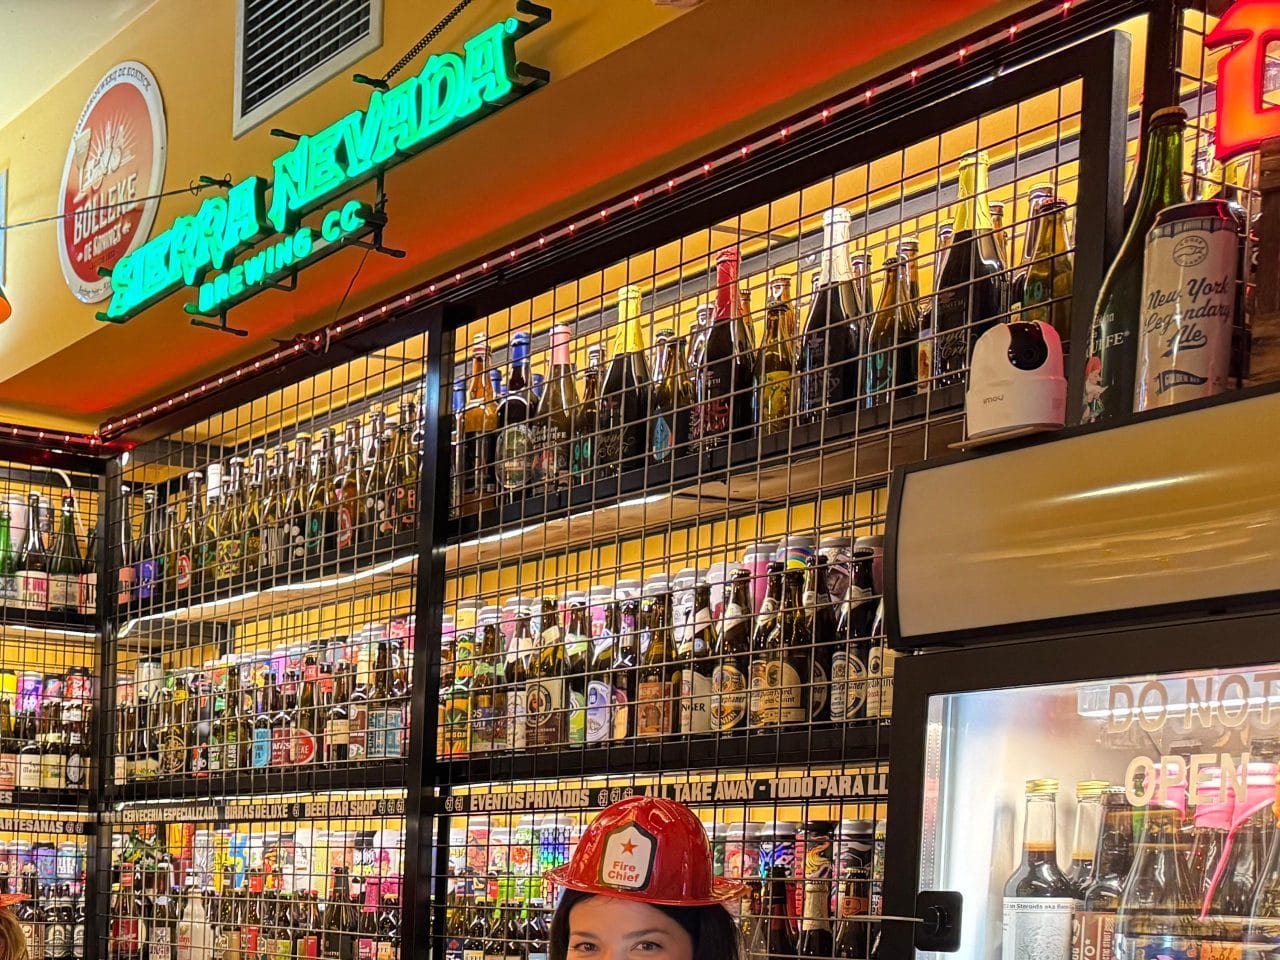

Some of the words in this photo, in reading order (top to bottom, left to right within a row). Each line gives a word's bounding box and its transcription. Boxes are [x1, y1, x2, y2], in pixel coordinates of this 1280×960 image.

[74, 174, 138, 244] BOLLEKE
[1147, 289, 1182, 311] New
[1187, 276, 1229, 298] York
[1144, 298, 1232, 336] Legendary
[1108, 680, 1170, 734] DO
[673, 781, 712, 803] TAKE
[714, 779, 756, 801] AWAY
[767, 778, 819, 801] TODO
[820, 776, 864, 799] PARA
[1124, 752, 1248, 807] OPEN
[163, 805, 218, 821] ESPECIALIZADA
[225, 804, 254, 820] BIRRAS
[254, 802, 288, 819] DELUXE
[305, 801, 328, 817] BEER
[329, 800, 348, 816] BAR
[349, 799, 377, 816] SHOP
[470, 791, 522, 811] EVENTOS
[521, 788, 589, 809] PRIVADOS
[608, 870, 640, 882] Chief
[613, 861, 636, 872] Fire
